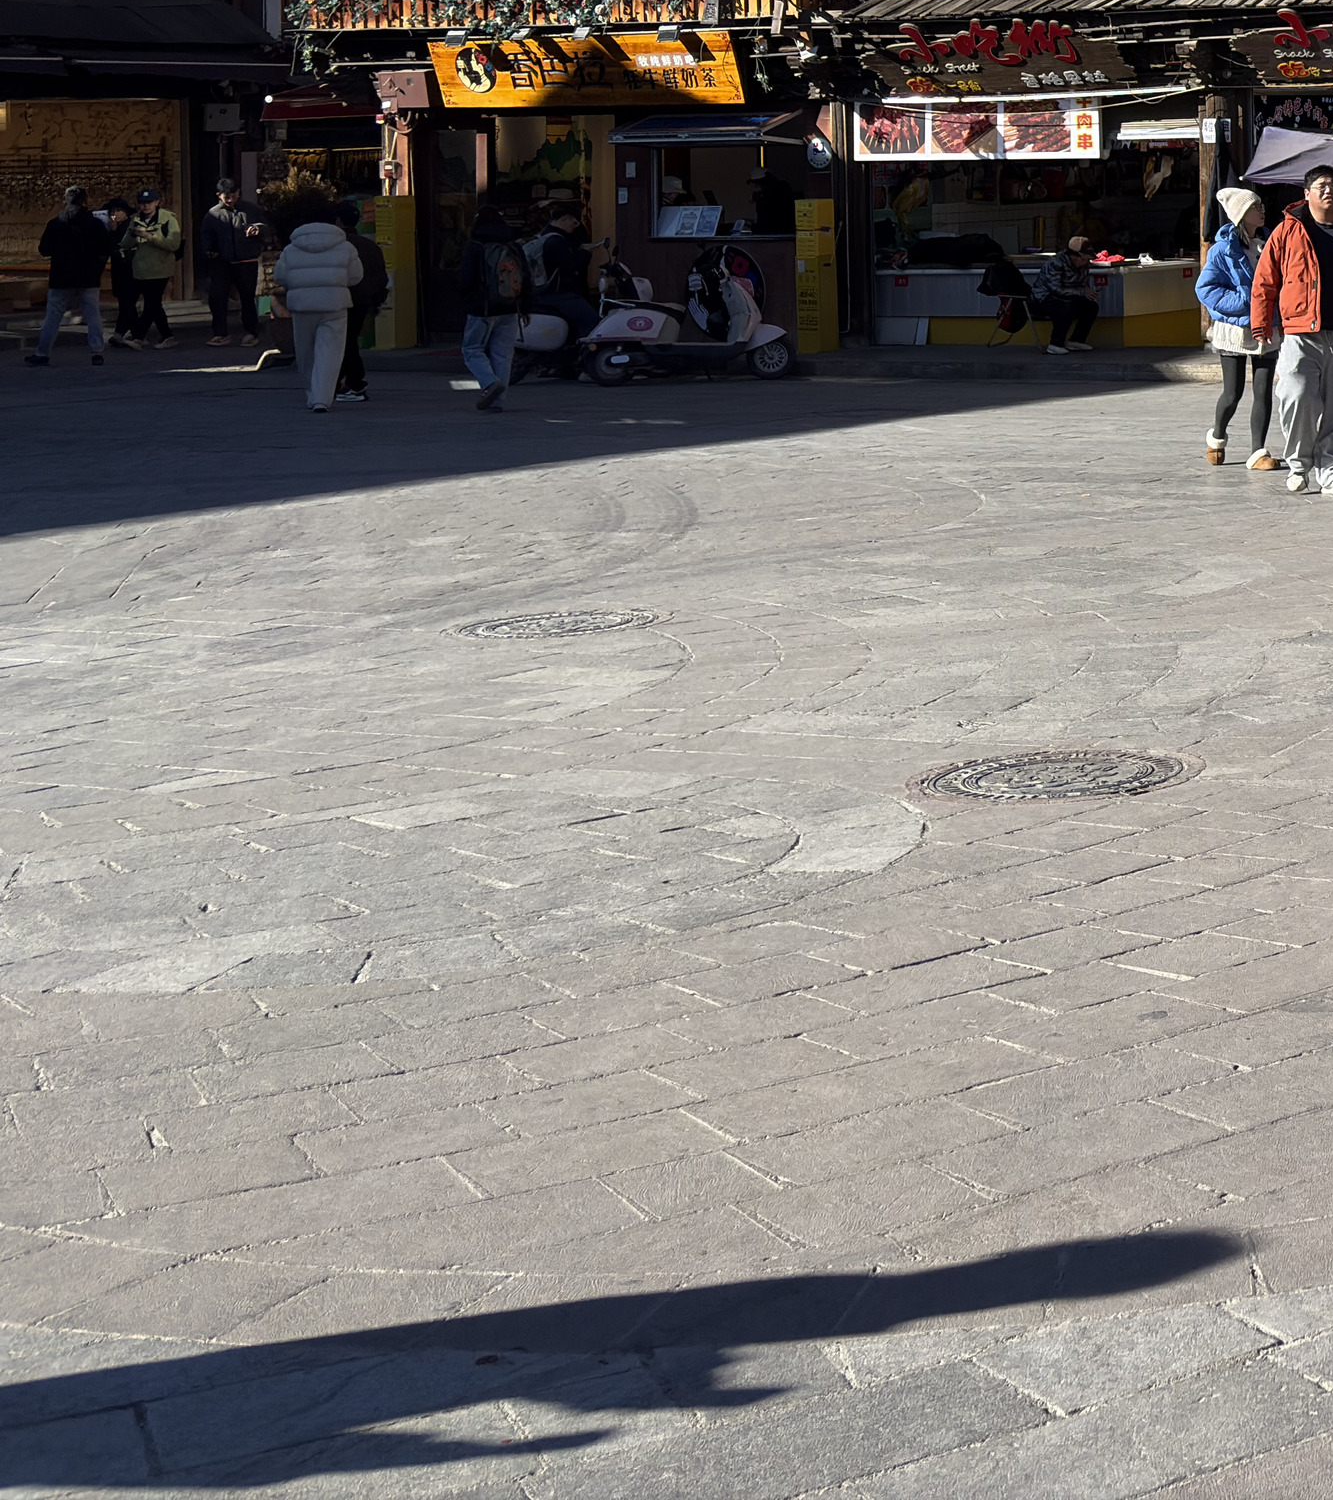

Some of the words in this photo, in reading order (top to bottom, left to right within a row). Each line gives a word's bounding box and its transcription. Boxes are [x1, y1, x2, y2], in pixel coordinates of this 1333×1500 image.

[898, 19, 1078, 64] 小吃街
[1273, 49, 1315, 60] Snack
[1020, 70, 1109, 88] 香格里拉
